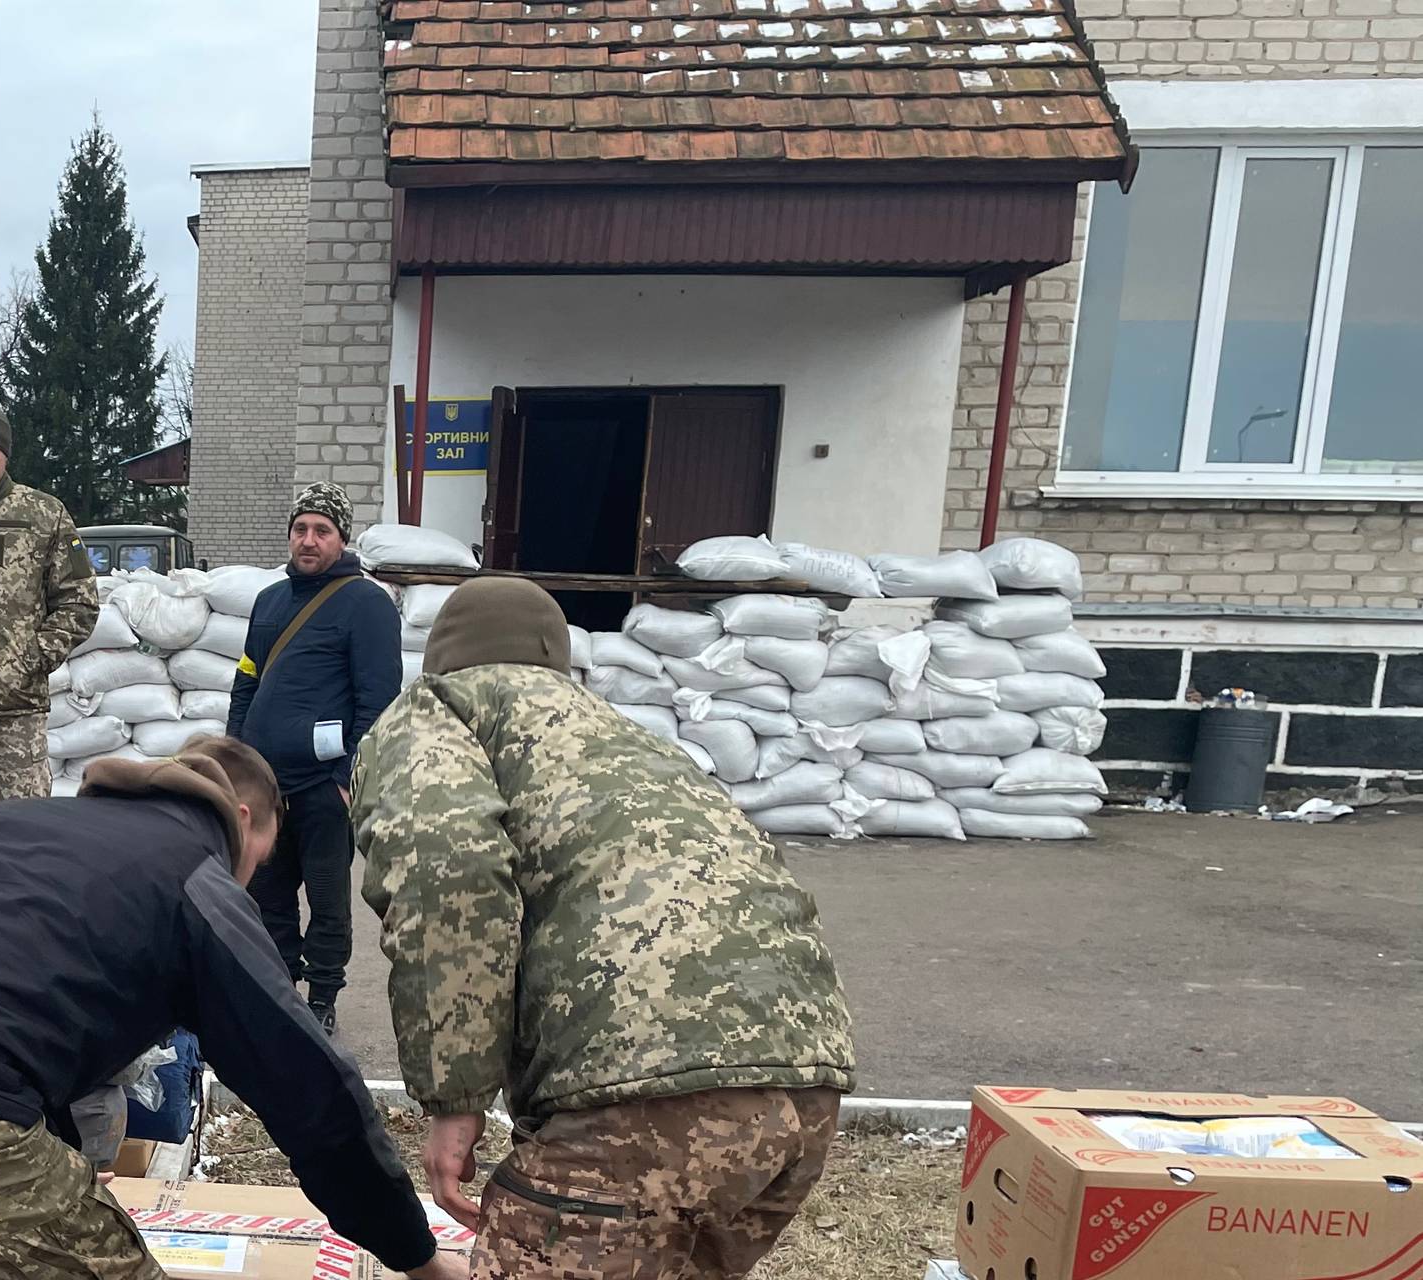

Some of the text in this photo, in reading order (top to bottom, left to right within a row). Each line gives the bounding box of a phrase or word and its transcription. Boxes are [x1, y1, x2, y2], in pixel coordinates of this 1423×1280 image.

[405, 431, 490, 444] СОРТИВНИ
[436, 447, 465, 459] ЗАЛ
[1088, 1196, 1125, 1228] GUT
[1110, 1216, 1127, 1230] &
[1207, 1206, 1370, 1238] BANANEN
[1089, 1200, 1169, 1263] GÜNSTIG
